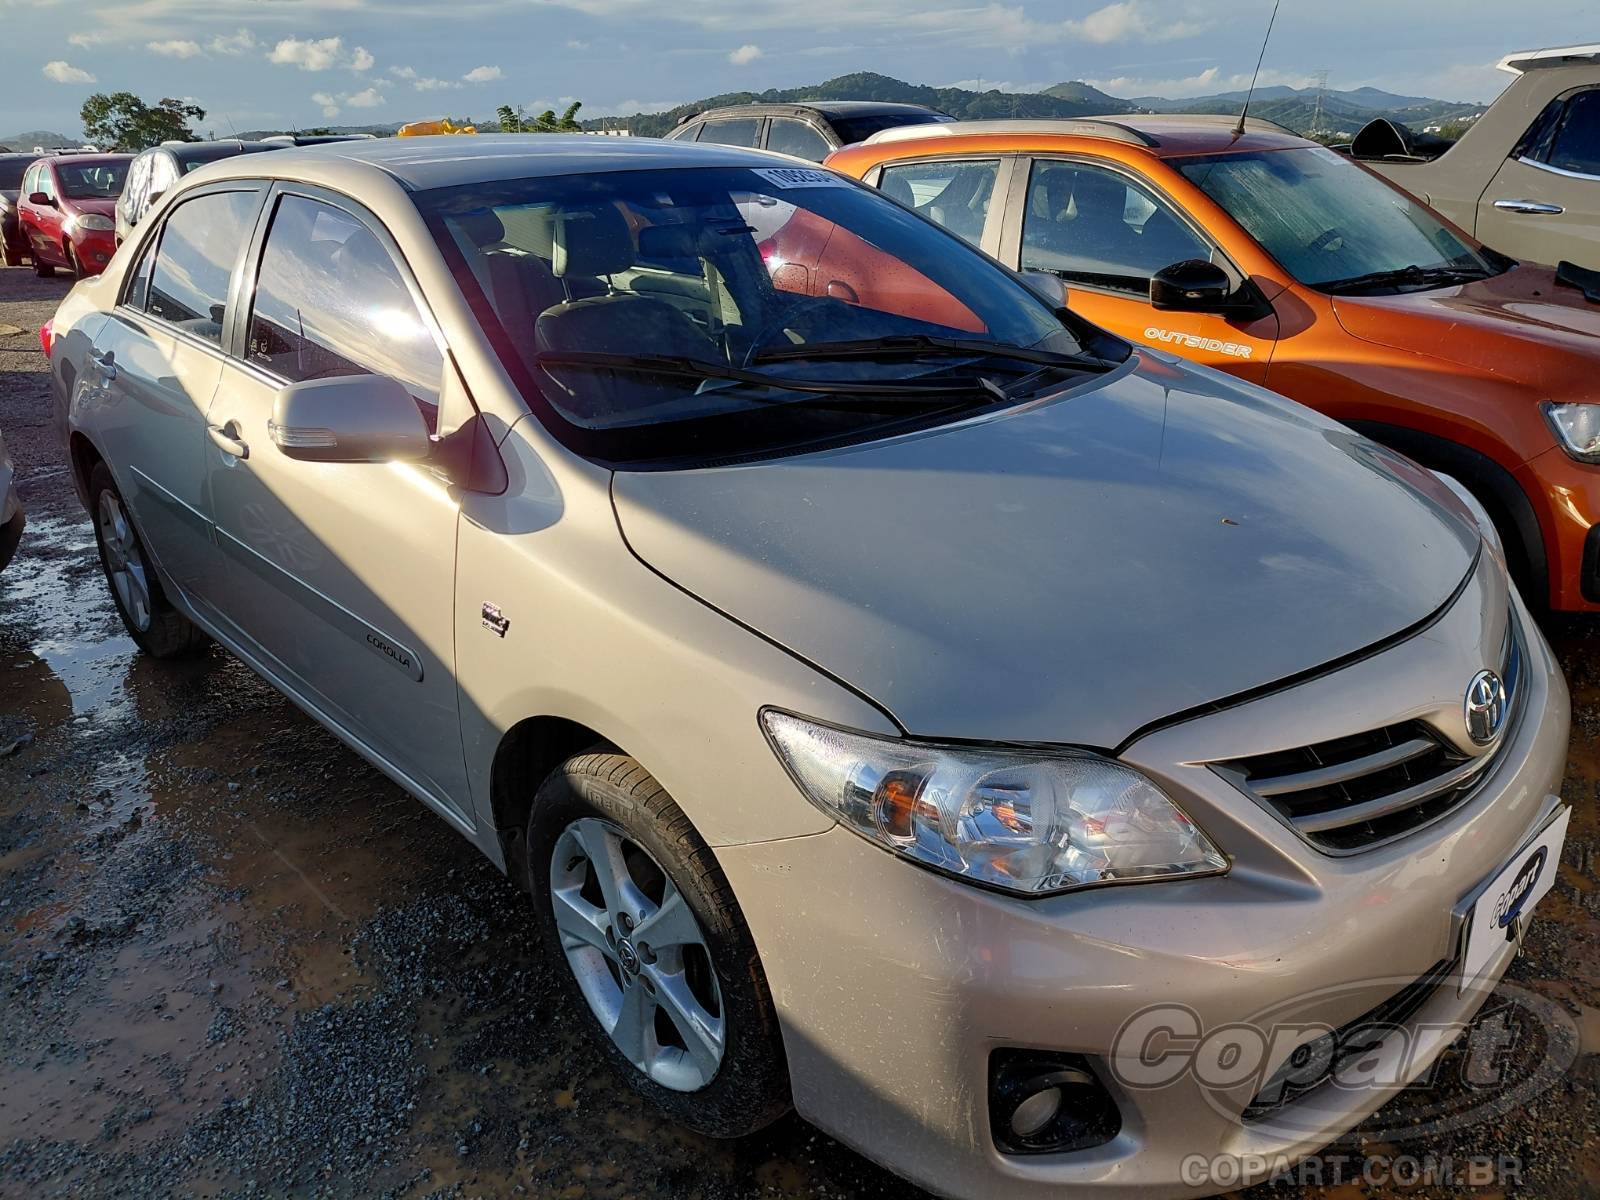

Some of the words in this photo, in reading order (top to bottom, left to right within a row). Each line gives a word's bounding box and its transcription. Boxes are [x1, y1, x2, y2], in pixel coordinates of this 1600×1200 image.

[1143, 327, 1252, 359] OUTSIDER
[366, 633, 411, 669] COROLLA
[1490, 857, 1541, 929] Copart
